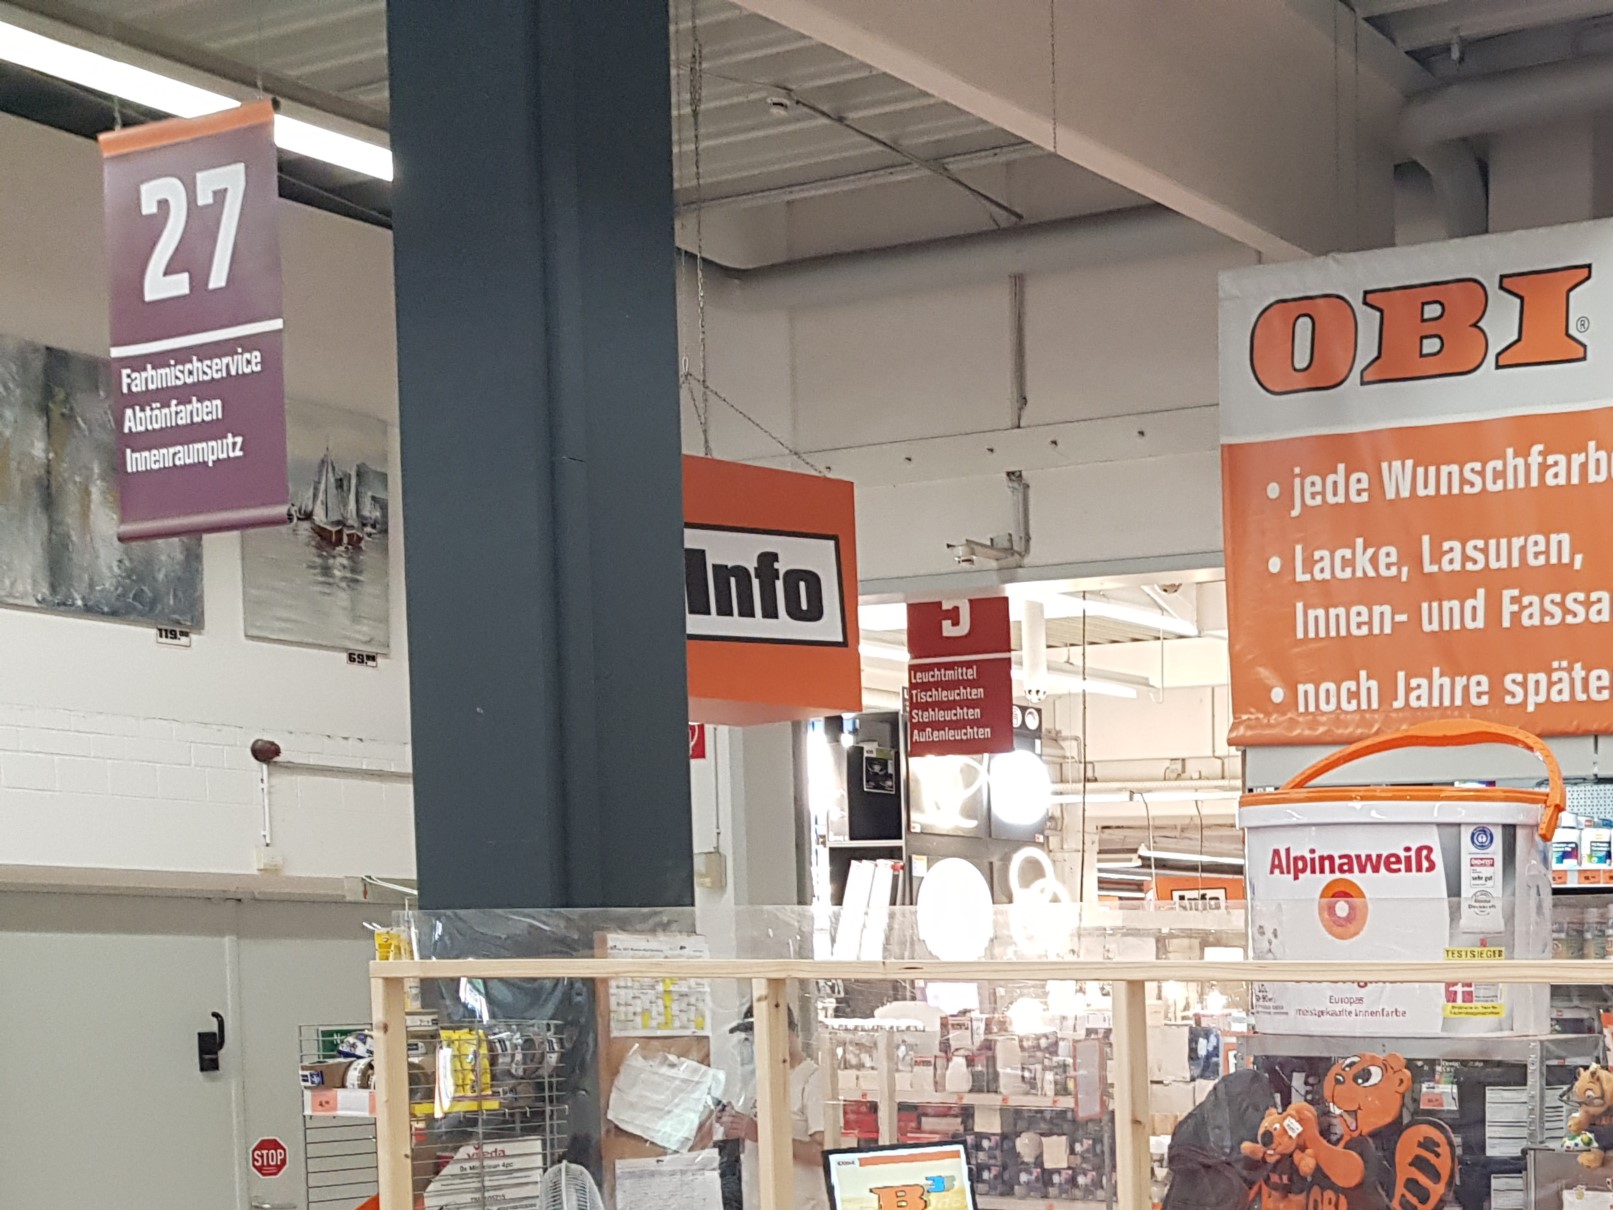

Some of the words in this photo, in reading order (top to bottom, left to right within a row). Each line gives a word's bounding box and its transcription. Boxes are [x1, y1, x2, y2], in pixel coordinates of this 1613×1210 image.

[139, 162, 246, 302] 27
[1249, 263, 1592, 396] OBI
[120, 348, 263, 395] Farbmischservice
[123, 395, 224, 434] Abtönfarben
[125, 432, 244, 474] Innenraumputz
[1290, 460, 1370, 518] jede
[1294, 543, 1409, 584] Lacke,
[1421, 528, 1585, 576] Lasuren,
[684, 547, 825, 623] Info
[1295, 600, 1409, 640] Innen-
[1421, 588, 1485, 632] und
[911, 665, 977, 683] Leuchtmittel
[1297, 675, 1381, 714] noch
[1392, 665, 1490, 709] Jahre
[911, 687, 984, 703] Tischleuchten
[912, 706, 981, 722] Stehleuchten
[912, 726, 991, 742] Außenleuchten
[1269, 845, 1436, 881] Alpinaweiß
[1178, 893, 1221, 911] Info
[1329, 995, 1364, 1005] Europas
[253, 1150, 285, 1167] STOP
